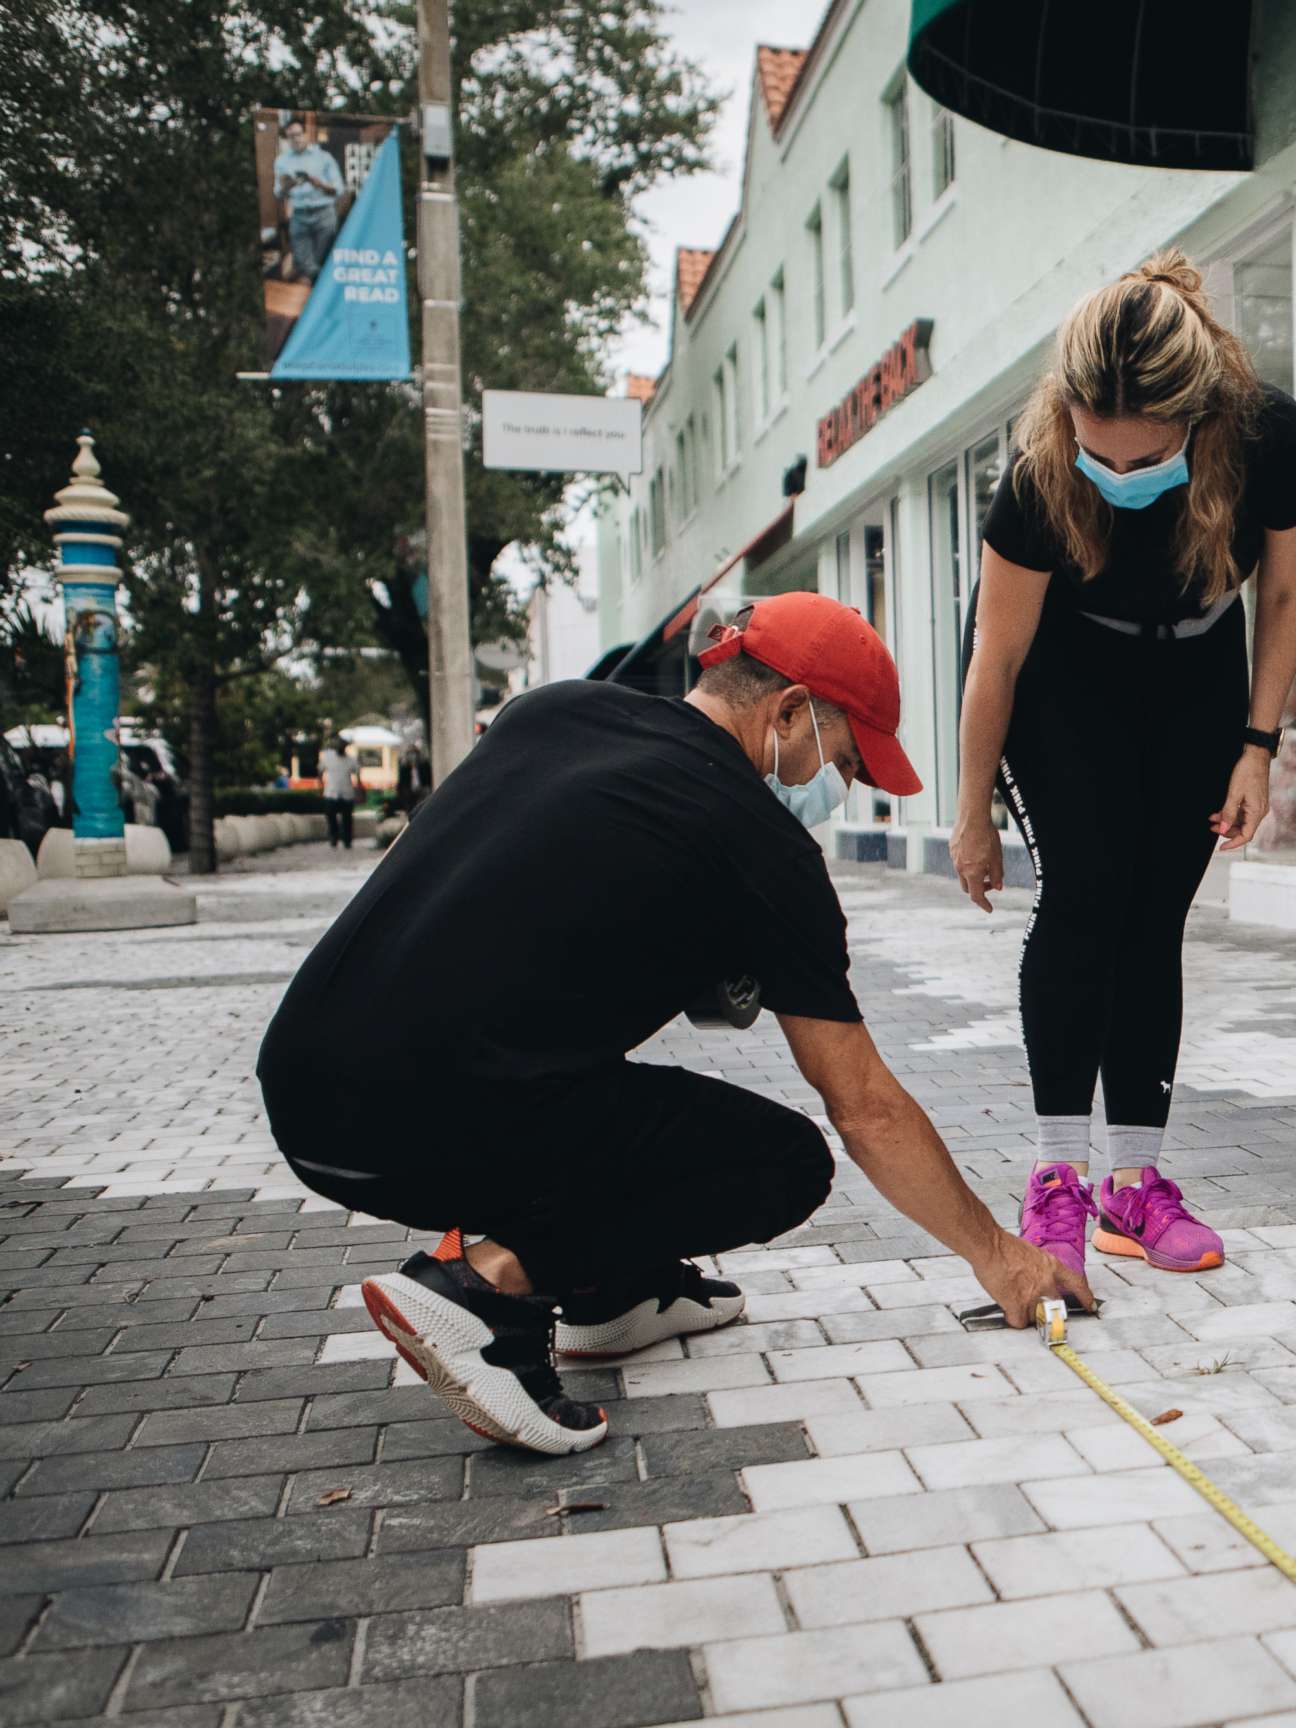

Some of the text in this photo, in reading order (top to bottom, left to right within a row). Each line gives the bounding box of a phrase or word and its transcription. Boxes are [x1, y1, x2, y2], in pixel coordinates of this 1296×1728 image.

[333, 248, 398, 266] FIND A
[333, 266, 399, 285] GREAT
[344, 285, 400, 304] READ
[502, 422, 521, 434] The
[1010, 785, 1026, 815] PINK
[1021, 815, 1036, 845] PINK
[1031, 846, 1043, 876] PINK
